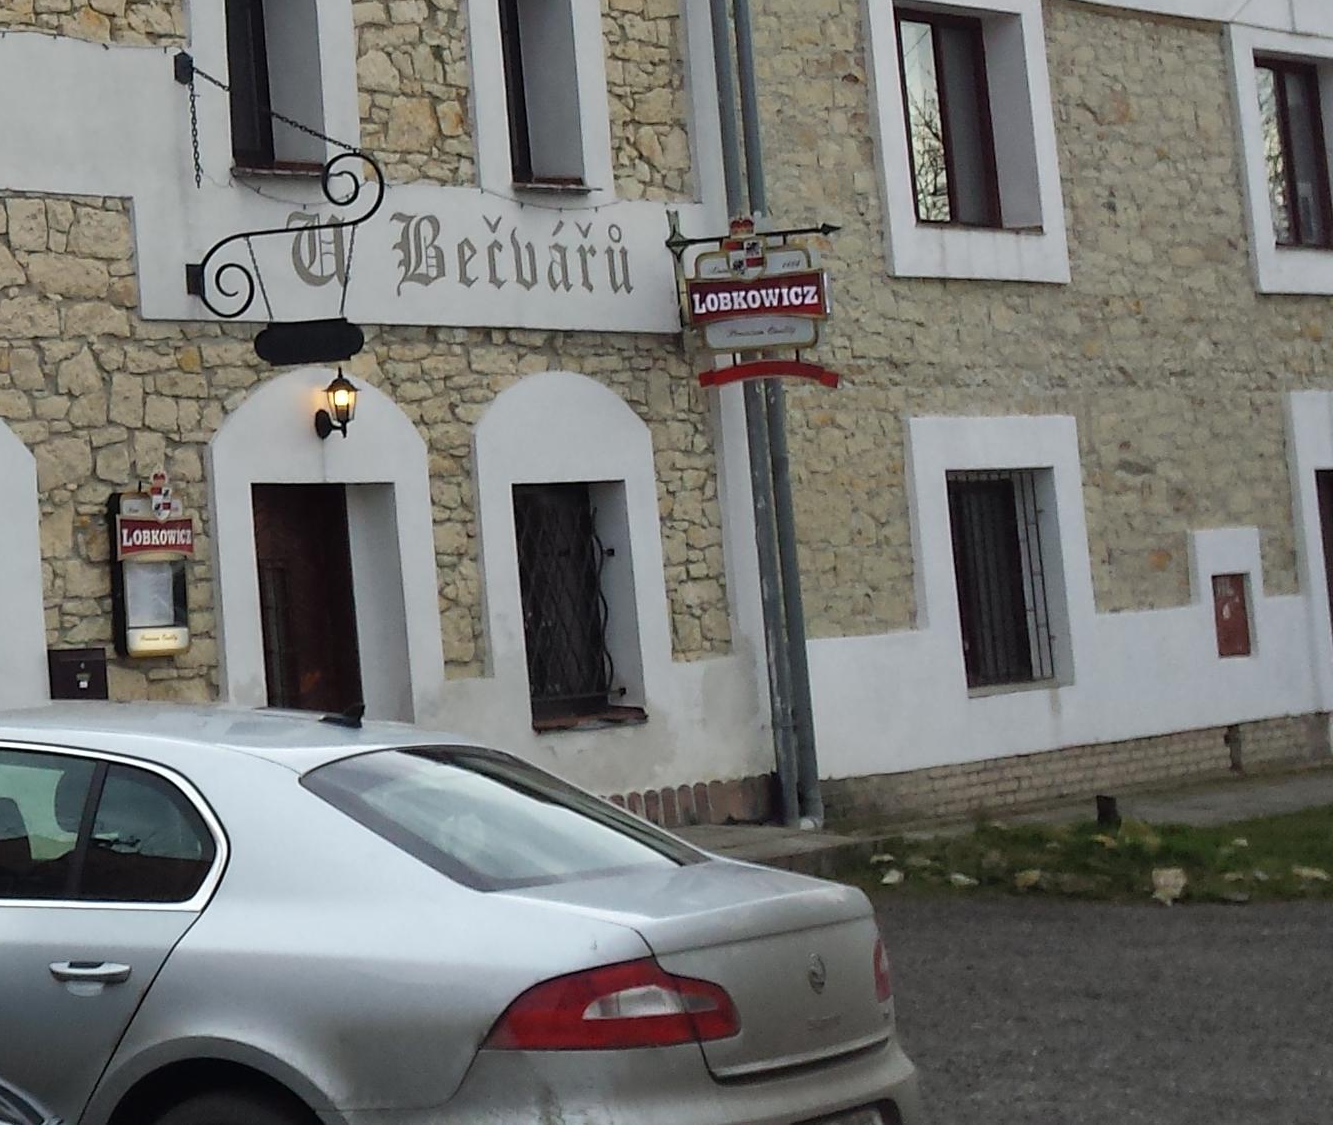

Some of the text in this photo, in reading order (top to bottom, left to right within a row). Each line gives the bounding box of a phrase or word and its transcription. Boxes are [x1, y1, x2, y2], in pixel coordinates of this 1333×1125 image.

[390, 211, 635, 297] Bečvářů
[692, 285, 819, 315] LOBKOWICZ
[121, 528, 192, 547] LOBKOWICZ
